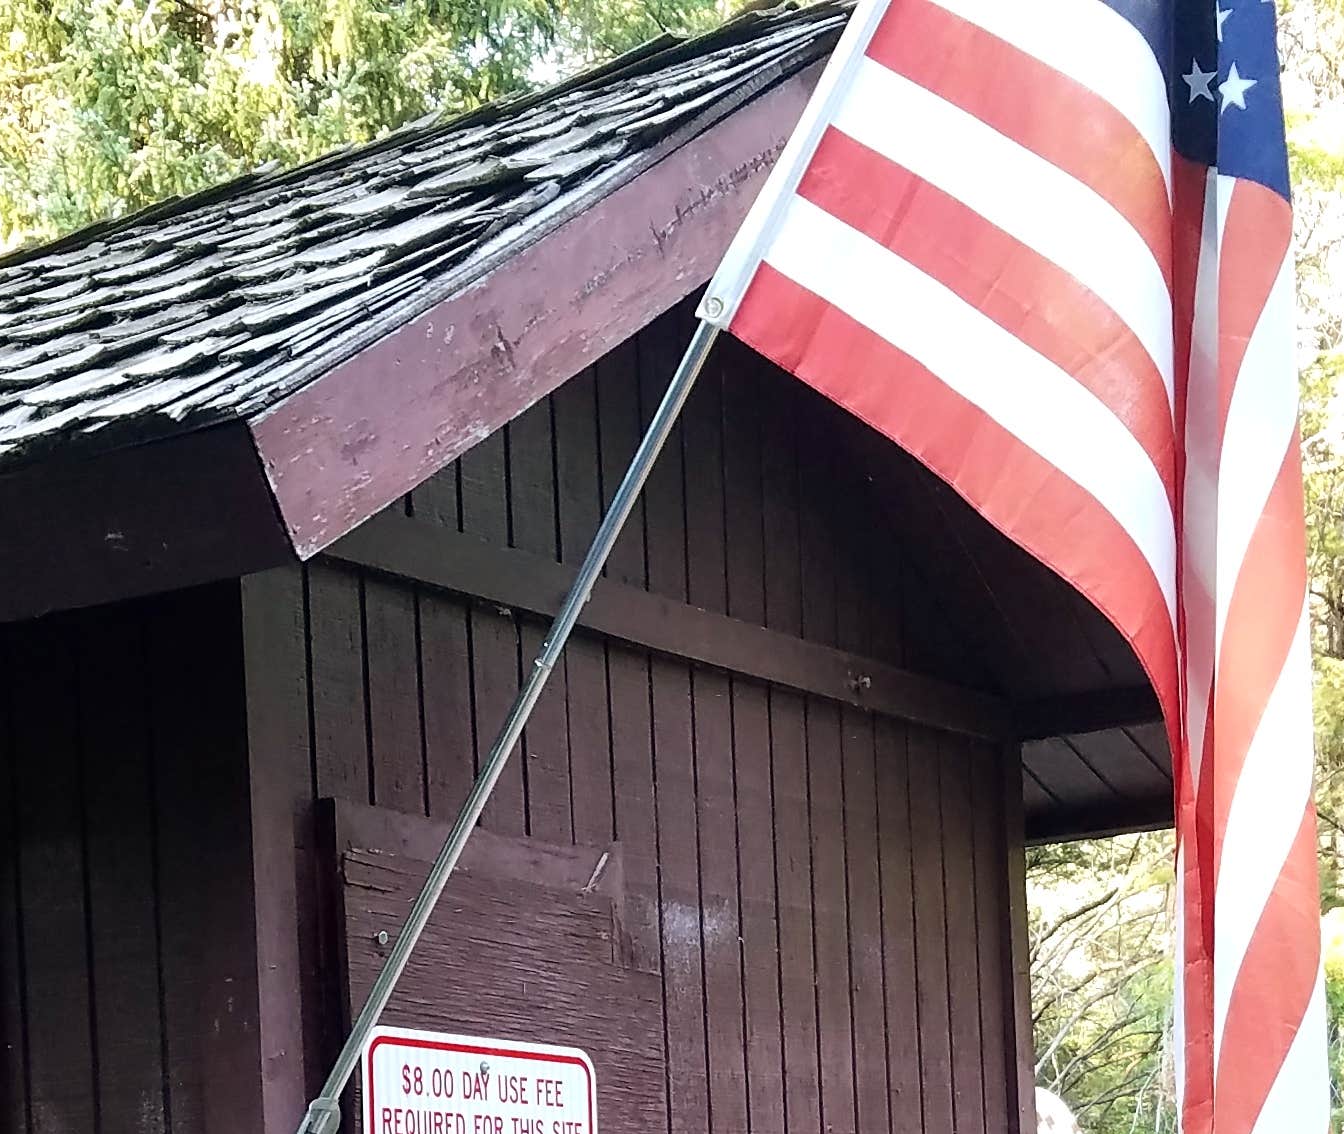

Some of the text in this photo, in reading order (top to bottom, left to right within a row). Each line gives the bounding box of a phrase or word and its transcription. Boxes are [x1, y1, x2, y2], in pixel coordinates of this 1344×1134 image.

[402, 1064, 564, 1107] $8.00 DAY USE FEE
